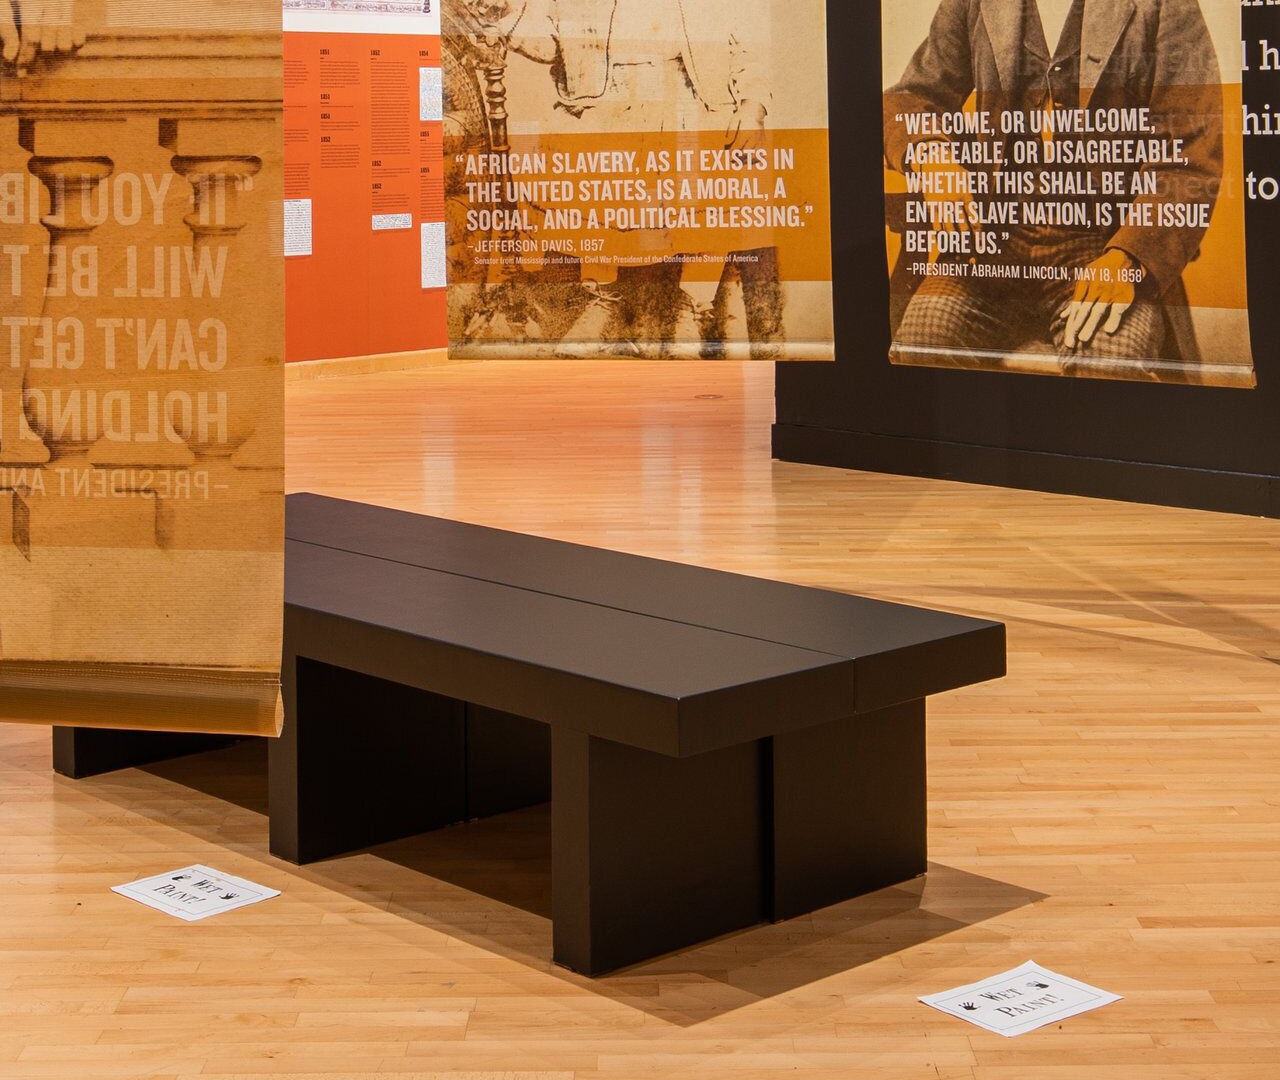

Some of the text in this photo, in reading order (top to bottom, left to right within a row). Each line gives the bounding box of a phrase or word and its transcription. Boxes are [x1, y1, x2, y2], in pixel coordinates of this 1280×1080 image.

[895, 108, 1156, 136] “WELCOME, OR UNWELCOME,
[455, 148, 794, 175] “AFRICAN SLAVERY, AS IT EXISTS IN
[905, 139, 1189, 166] AGREEABLE, OR DISAGREEABLE,
[465, 177, 787, 203] THE UNITED STATES, IS A MORAL, A
[905, 171, 988, 194] WHETHER
[993, 171, 1034, 195] THIS
[1039, 171, 1097, 195] SHALL
[1102, 171, 1125, 195] BE
[1130, 171, 1157, 195] AN
[1246, 171, 1279, 200] to
[466, 205, 813, 232] SOCIAL, AND A POLITICAL BLESSING.”
[905, 200, 1210, 229] ENTIRE SLAVE NATION, IS THE ISSUE
[541, 239, 577, 252] DAVIS,
[580, 239, 605, 252] 1857
[905, 230, 1010, 254] BEFORE US.”
[474, 254, 759, 266] Senator from Mississippi and future Civil War President of the Confederate States of America
[971, 263, 1020, 279] ABRAHAM
[1023, 265, 1071, 281] LINCOLN,
[1074, 267, 1096, 281] MAY
[1099, 267, 1113, 283] 18,
[1117, 268, 1142, 283] 1858
